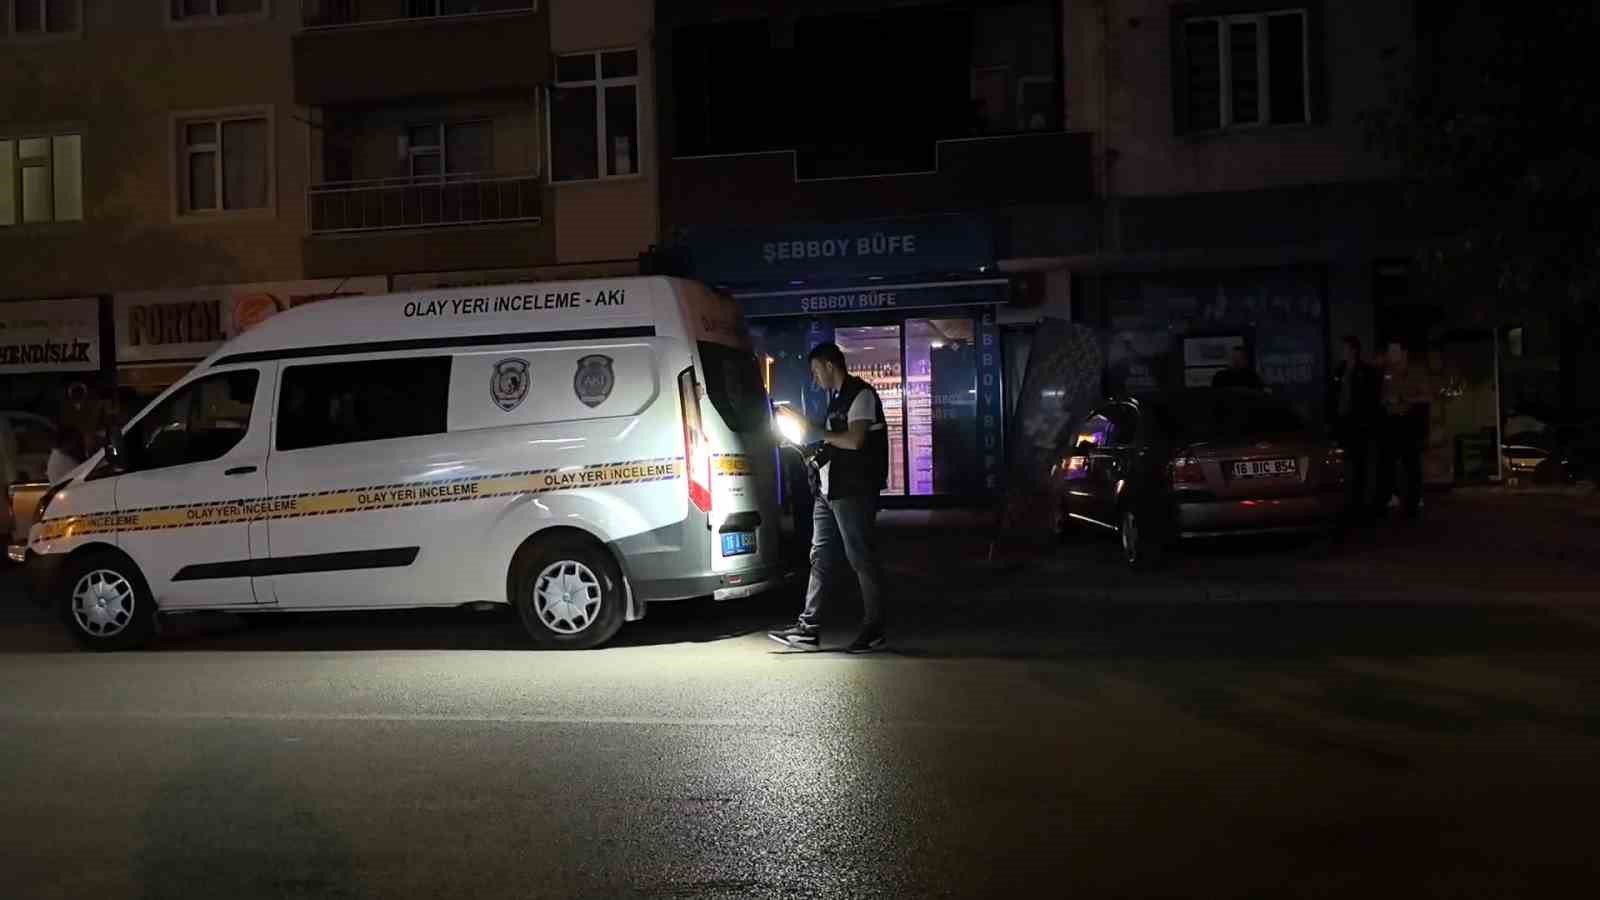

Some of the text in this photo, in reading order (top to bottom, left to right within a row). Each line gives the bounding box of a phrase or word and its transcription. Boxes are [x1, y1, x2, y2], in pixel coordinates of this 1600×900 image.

[763, 232, 915, 263] ŞEBBOY BÜFE
[800, 290, 896, 313] ŞEBBOY BÜFE
[403, 302, 447, 318] OLAY
[543, 473, 576, 486] OLAY
[357, 491, 388, 504] OLAY
[186, 507, 213, 520] OLAY
